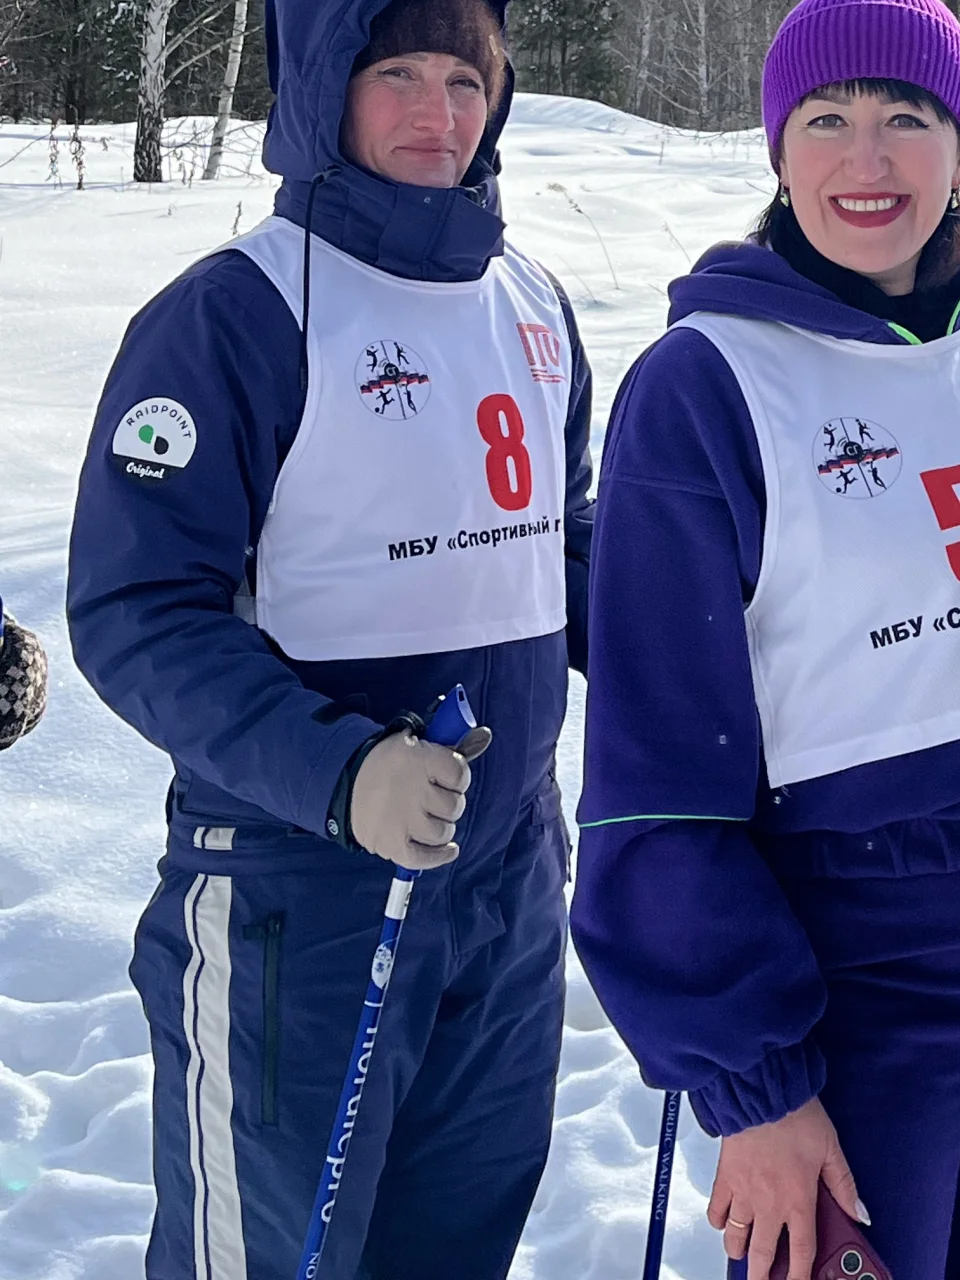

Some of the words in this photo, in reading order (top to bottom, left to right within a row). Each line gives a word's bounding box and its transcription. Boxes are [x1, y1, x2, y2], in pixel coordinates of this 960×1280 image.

[126, 405, 192, 439] RAIDPOINT
[126, 462, 165, 479] Original
[476, 393, 533, 512] 8
[388, 535, 438, 561] МБУ
[447, 515, 550, 550] «Спортивный
[869, 615, 923, 650] МБУ
[654, 1150, 671, 1220] WALKING
